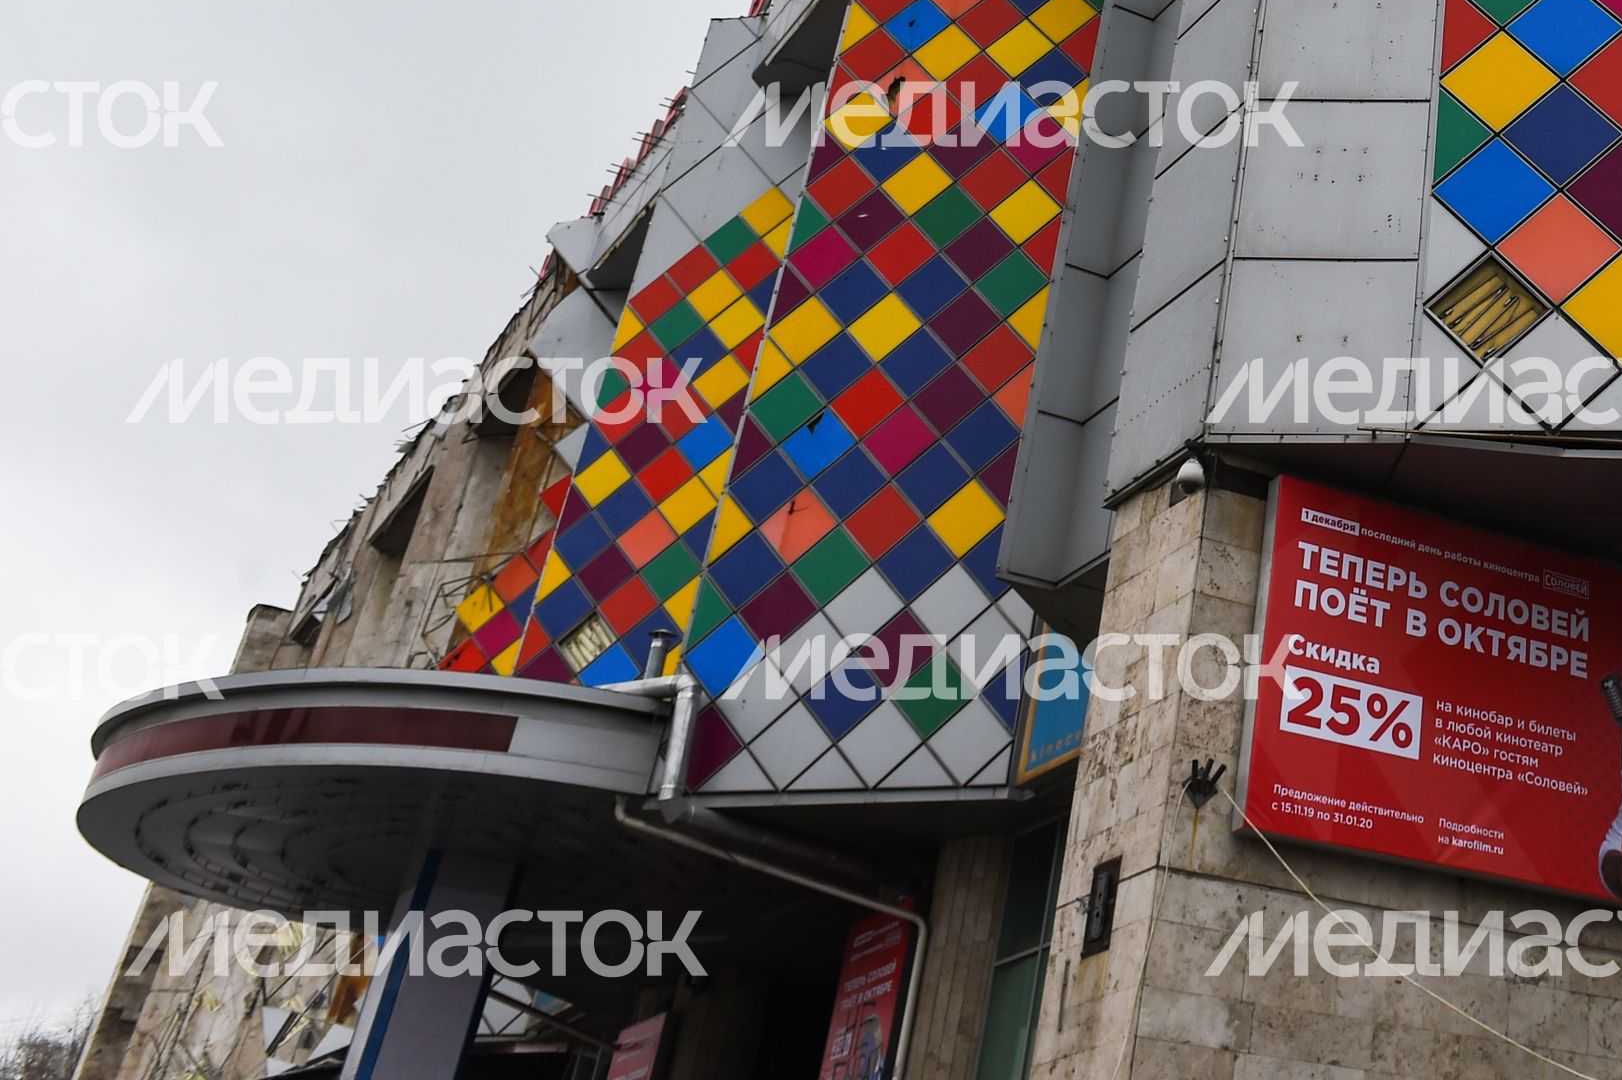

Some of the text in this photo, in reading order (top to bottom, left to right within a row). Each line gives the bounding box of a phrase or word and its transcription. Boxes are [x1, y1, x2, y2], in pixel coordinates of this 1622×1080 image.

[1312, 513, 1356, 532] декабря
[1361, 527, 1416, 549] последний
[1418, 543, 1442, 557] день
[1444, 551, 1481, 567] работы
[1483, 561, 1540, 583] киноцентра
[1298, 541, 1590, 642] ТЕПЕРЬ СОЛОВЕЙ
[1294, 579, 1588, 679] ПОЁТ В ОКТЯБРЕ
[1288, 634, 1380, 674] Скидка
[1287, 676, 1413, 749] 25%
[1436, 700, 1576, 742] на кинобар и билеты
[1434, 734, 1539, 768] «КАРО» гостям
[1435, 719, 1563, 757] в любой кинотеатр
[1433, 754, 1588, 796] киноцентра «Соловей»
[1271, 801, 1374, 830] с 15.11.19 по 31.01.20
[1273, 784, 1425, 824] Предложение действительно
[1438, 818, 1505, 841] Подробности
[1438, 835, 1504, 855] на karofilm.ru
